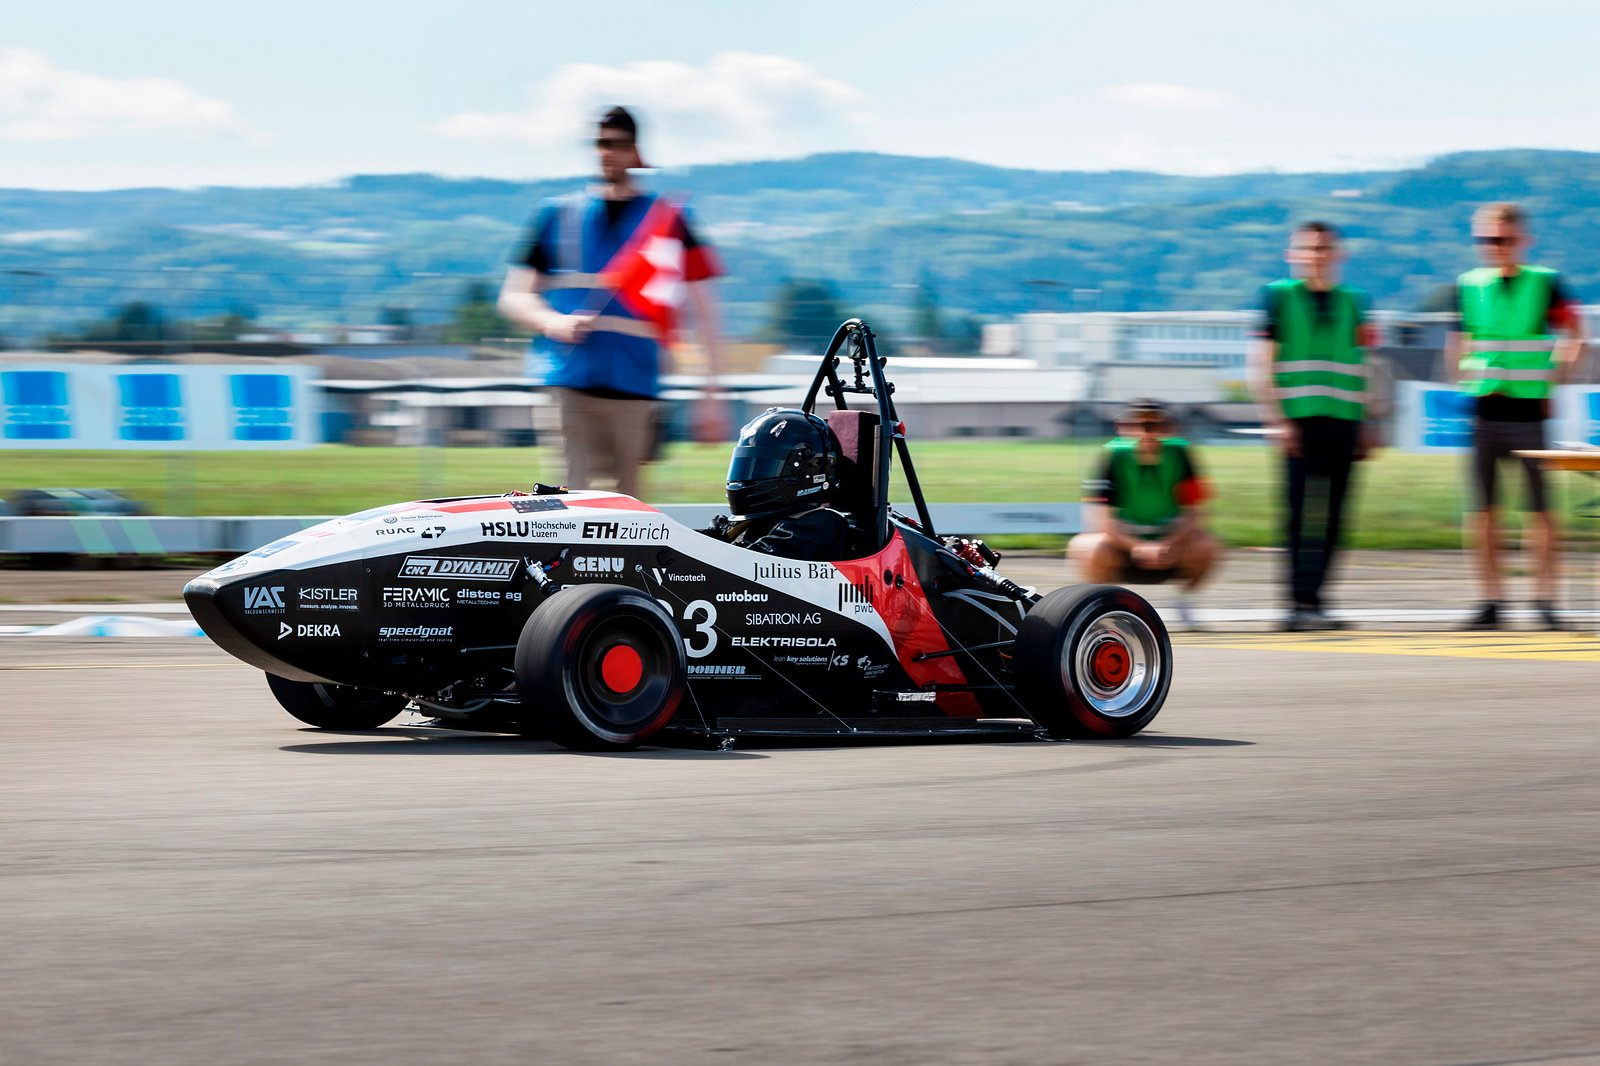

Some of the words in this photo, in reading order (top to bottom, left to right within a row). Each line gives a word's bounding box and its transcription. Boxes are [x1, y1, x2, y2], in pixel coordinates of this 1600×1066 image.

[375, 527, 416, 536] RUAG
[481, 521, 529, 537] HSLU
[531, 521, 577, 530] Hochschule
[531, 529, 558, 538] Luzern
[581, 522, 620, 539] ETH
[620, 523, 670, 540] zürich
[404, 566, 428, 575] CNC
[439, 560, 514, 575] DYNAMIX
[573, 556, 625, 573] GENU
[668, 573, 706, 582] Vincotech
[753, 562, 802, 582] Julius
[808, 562, 838, 579] Bär
[244, 586, 285, 609] VAC
[298, 587, 358, 601] KISTLER
[383, 587, 450, 602] FERAMIC
[457, 588, 501, 599] distec
[505, 591, 522, 602] ag
[716, 590, 769, 602] autobau
[854, 603, 874, 615] pwb
[745, 613, 801, 626] SIBATRON
[803, 612, 822, 625] AG
[297, 624, 341, 637] DEKRA
[378, 625, 454, 638] speedgoat
[731, 637, 837, 647] ELEKTRISOLA
[774, 655, 786, 663] lean
[786, 655, 799, 664] key
[799, 655, 828, 663] solutions
